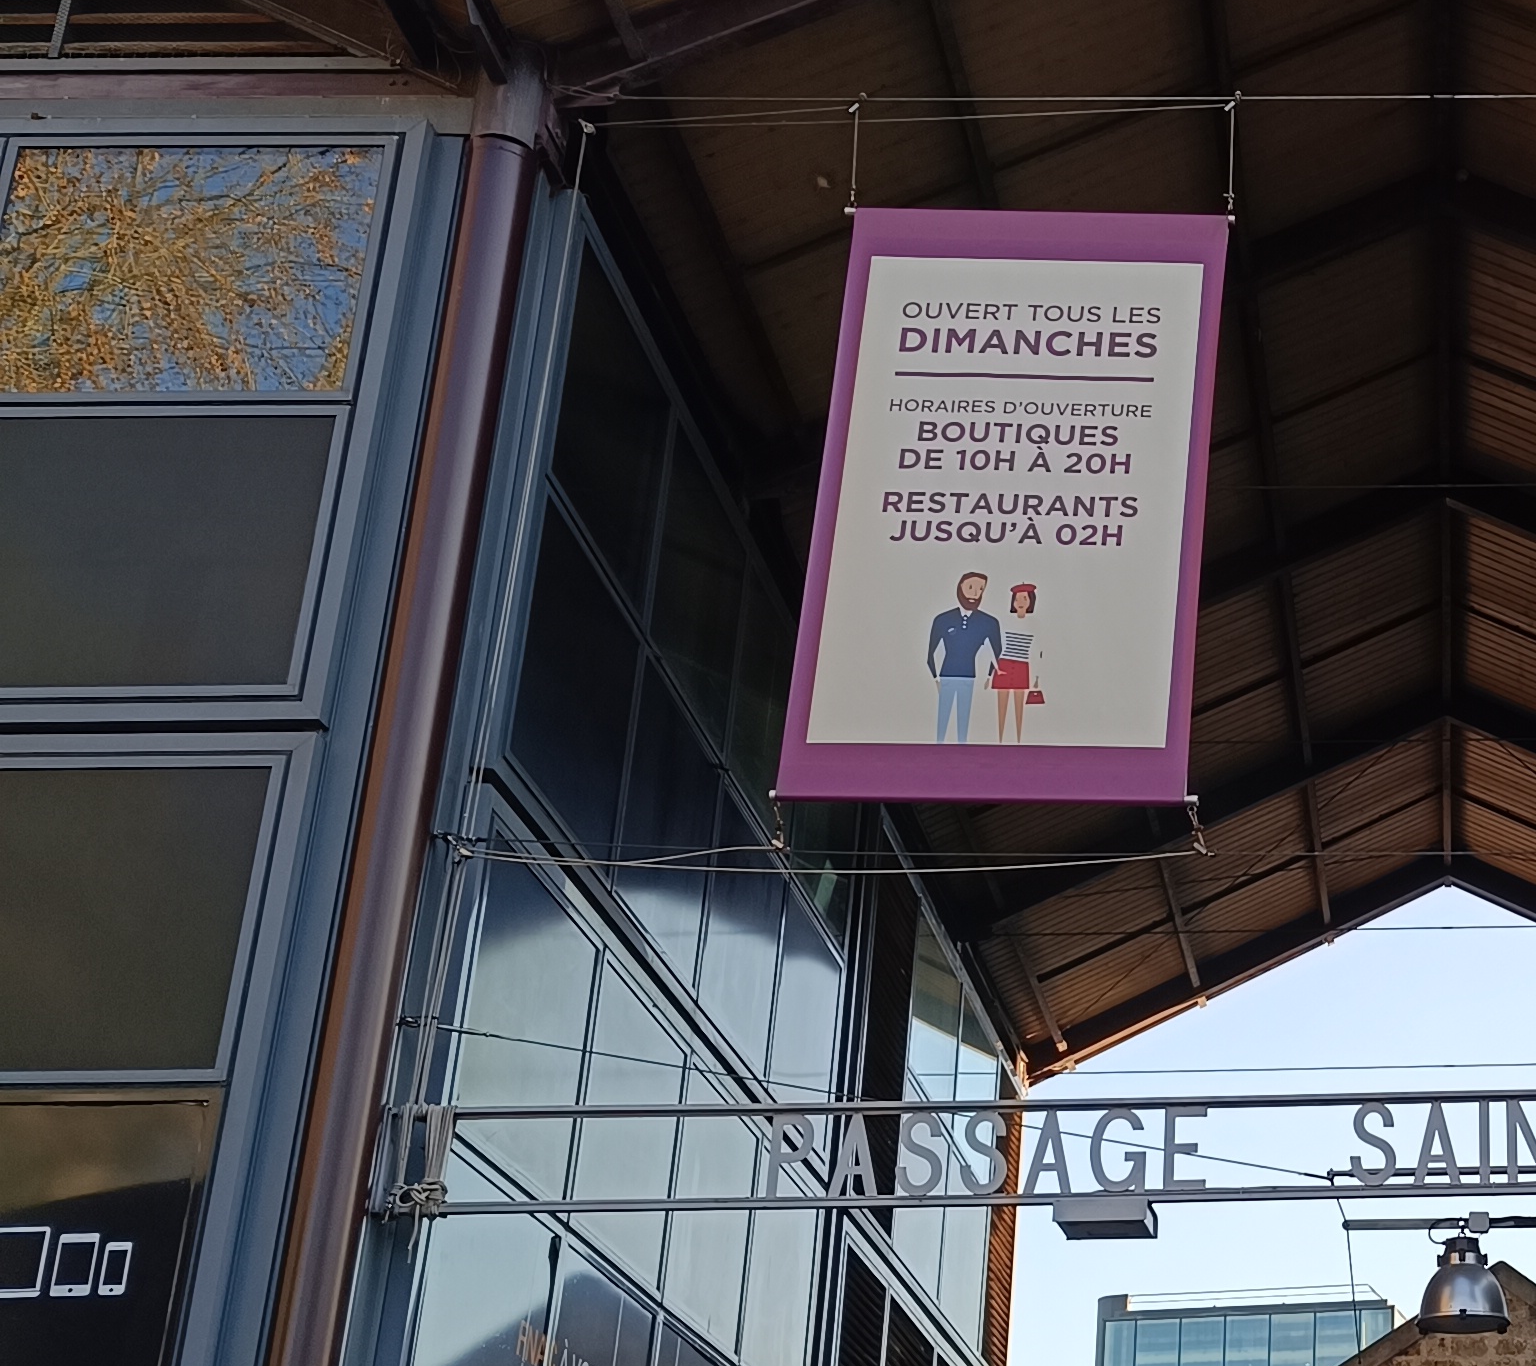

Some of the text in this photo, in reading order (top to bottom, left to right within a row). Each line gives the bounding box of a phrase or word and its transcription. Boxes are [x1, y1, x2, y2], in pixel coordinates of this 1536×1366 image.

[902, 301, 1161, 324] OUVERT TOUS LES
[898, 327, 1158, 359] DIMANCHES
[889, 398, 996, 414] HORAIRES
[917, 420, 1119, 448] BOUTIQUES
[898, 445, 1132, 475] DE 10H À 20H
[881, 491, 1139, 519] RESTAURANTS
[1055, 523, 1124, 547] 02H
[767, 1107, 1208, 1198] PASSAGE
